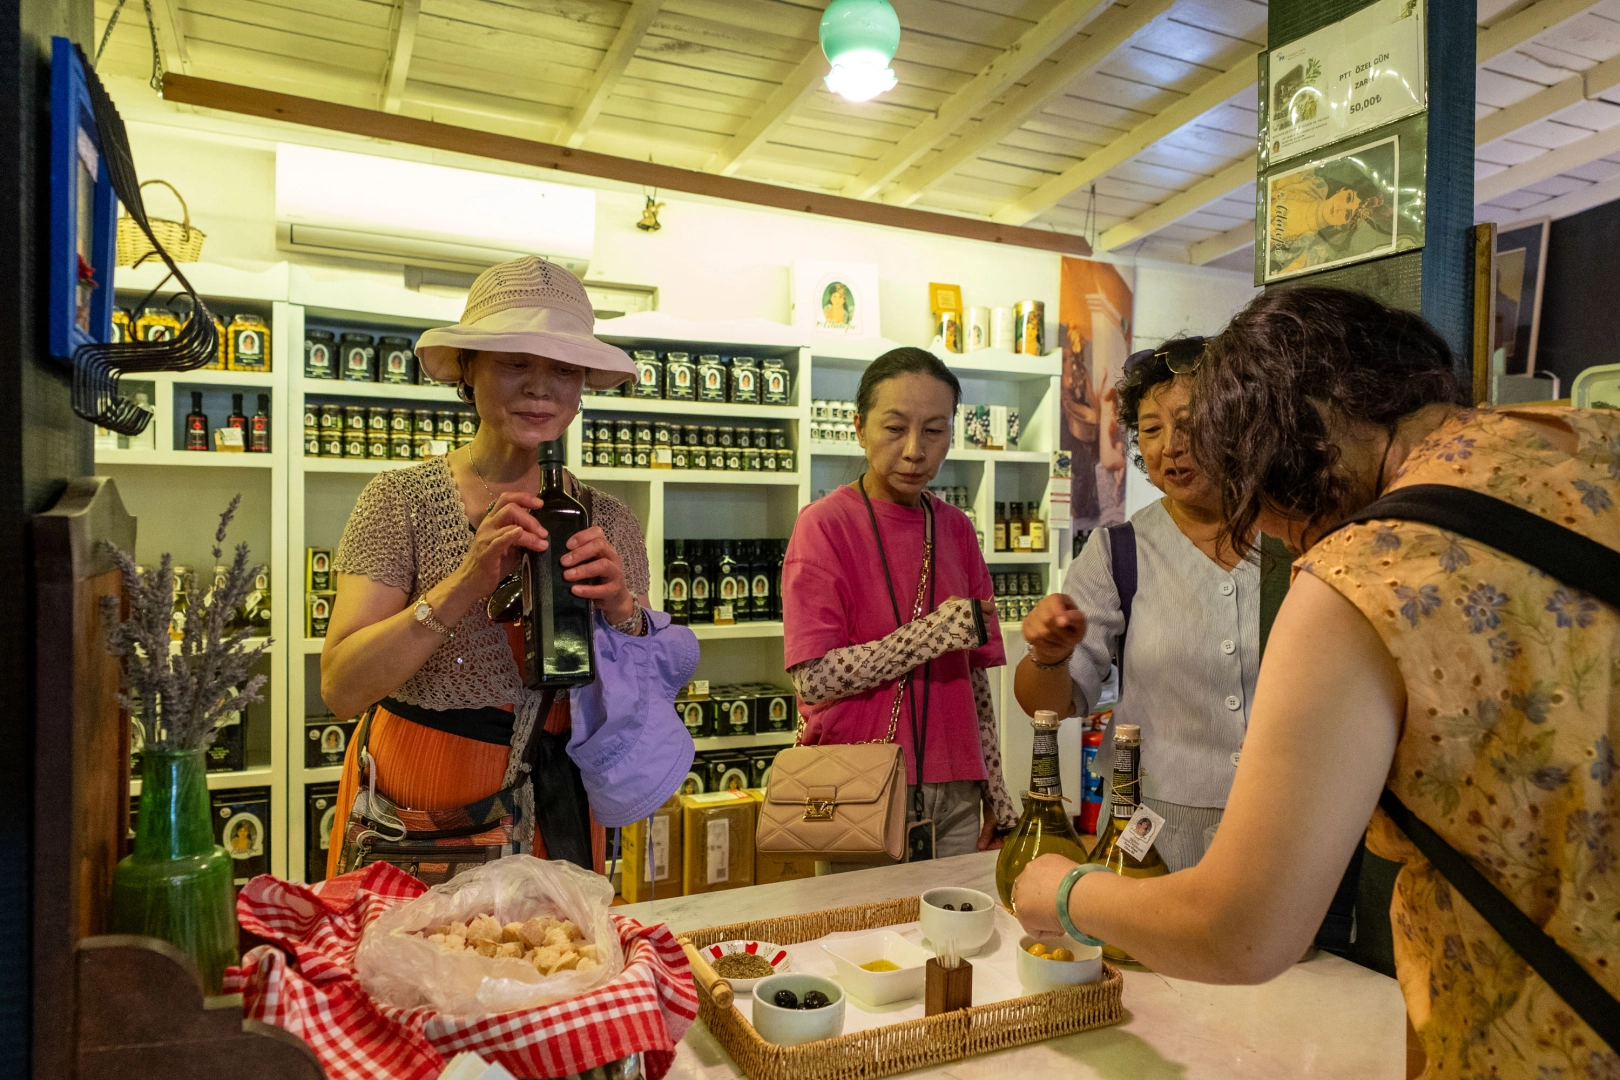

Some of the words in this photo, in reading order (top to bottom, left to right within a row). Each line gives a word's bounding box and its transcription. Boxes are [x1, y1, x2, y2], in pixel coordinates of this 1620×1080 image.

[1339, 70, 1352, 81] PTT
[1355, 61, 1372, 74] ÖZEL
[1373, 53, 1390, 65] GÜN
[1349, 94, 1382, 114] 50,00₺
